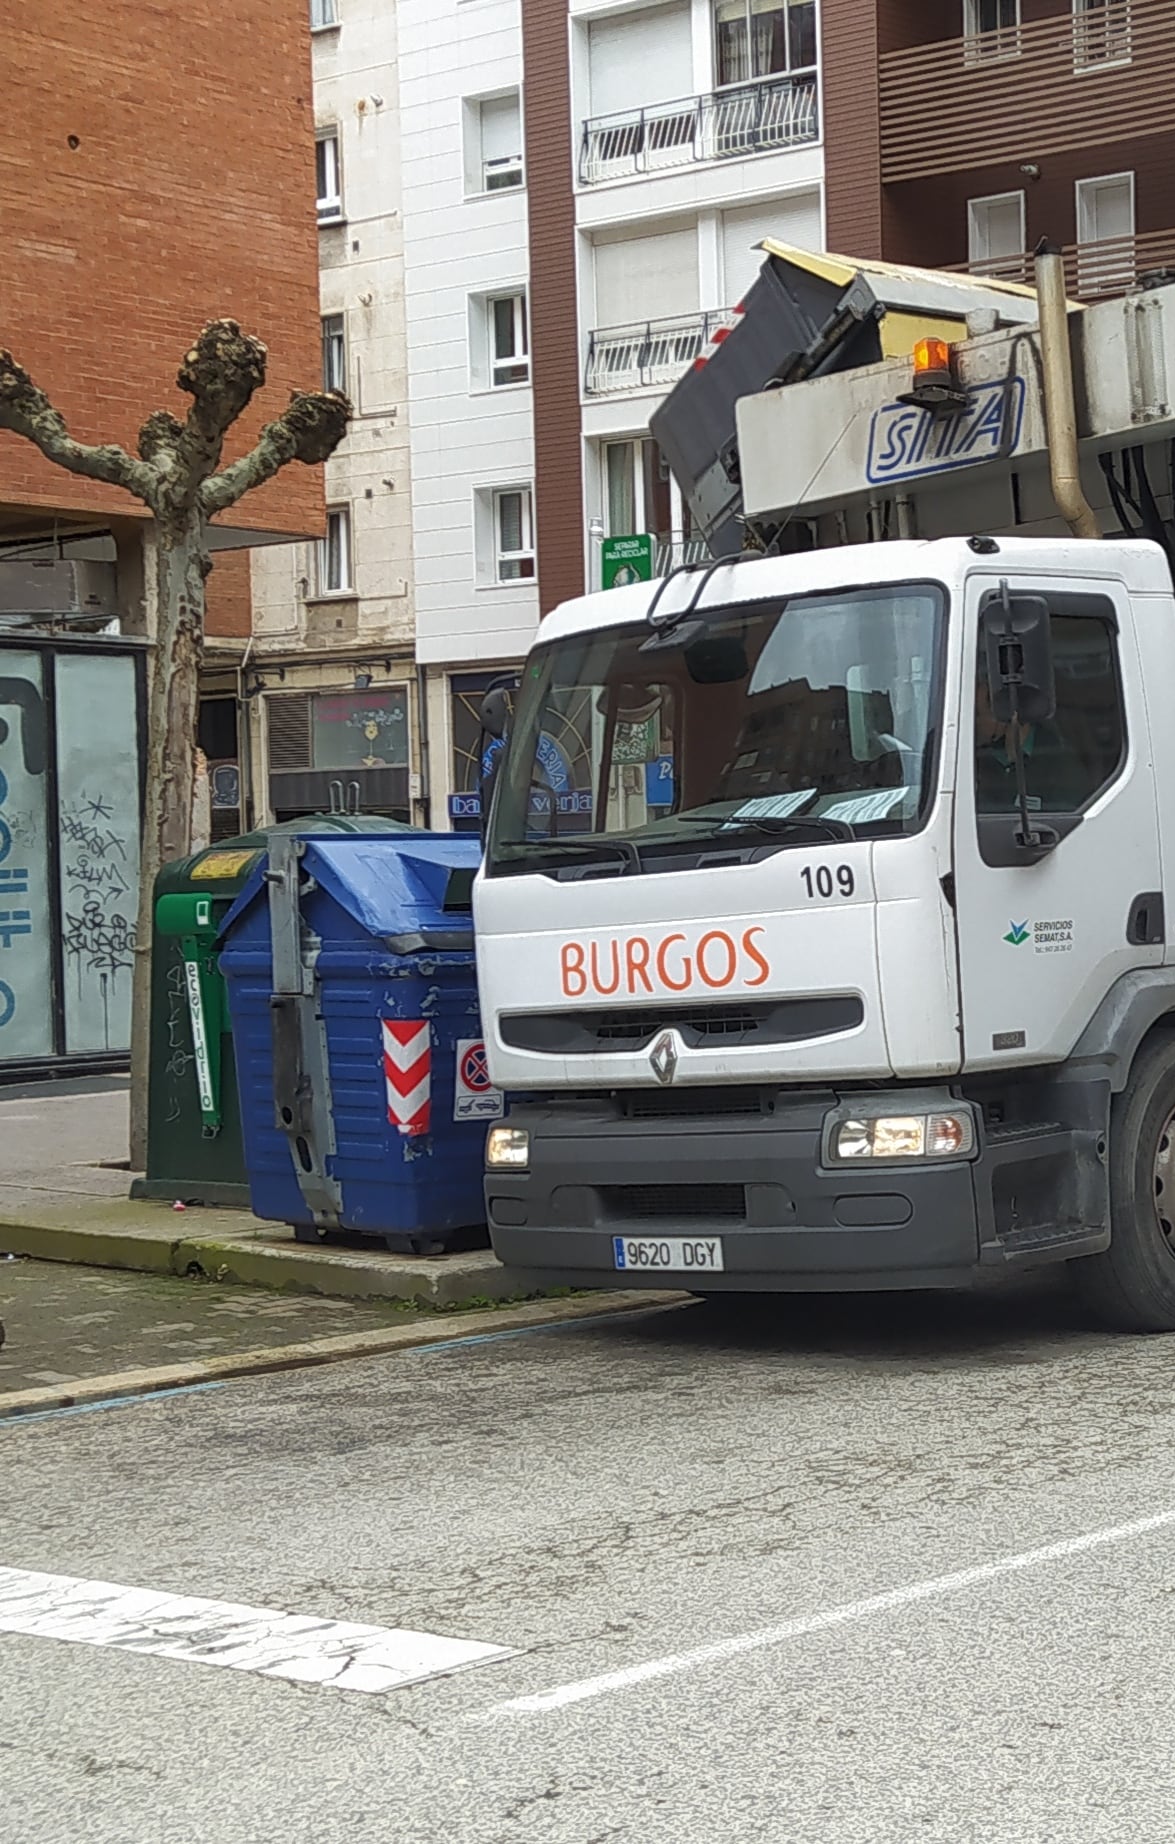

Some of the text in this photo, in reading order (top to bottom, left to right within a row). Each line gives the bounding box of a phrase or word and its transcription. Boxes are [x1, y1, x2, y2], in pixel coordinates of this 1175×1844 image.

[877, 393, 1005, 471] SITA
[452, 796, 480, 814] ba
[800, 864, 855, 898] 109
[1034, 920, 1073, 932] SERVICIOS
[560, 926, 770, 997] BURGOS
[187, 963, 212, 1109] ecovidrio
[627, 1241, 716, 1267] 9620 DGY
